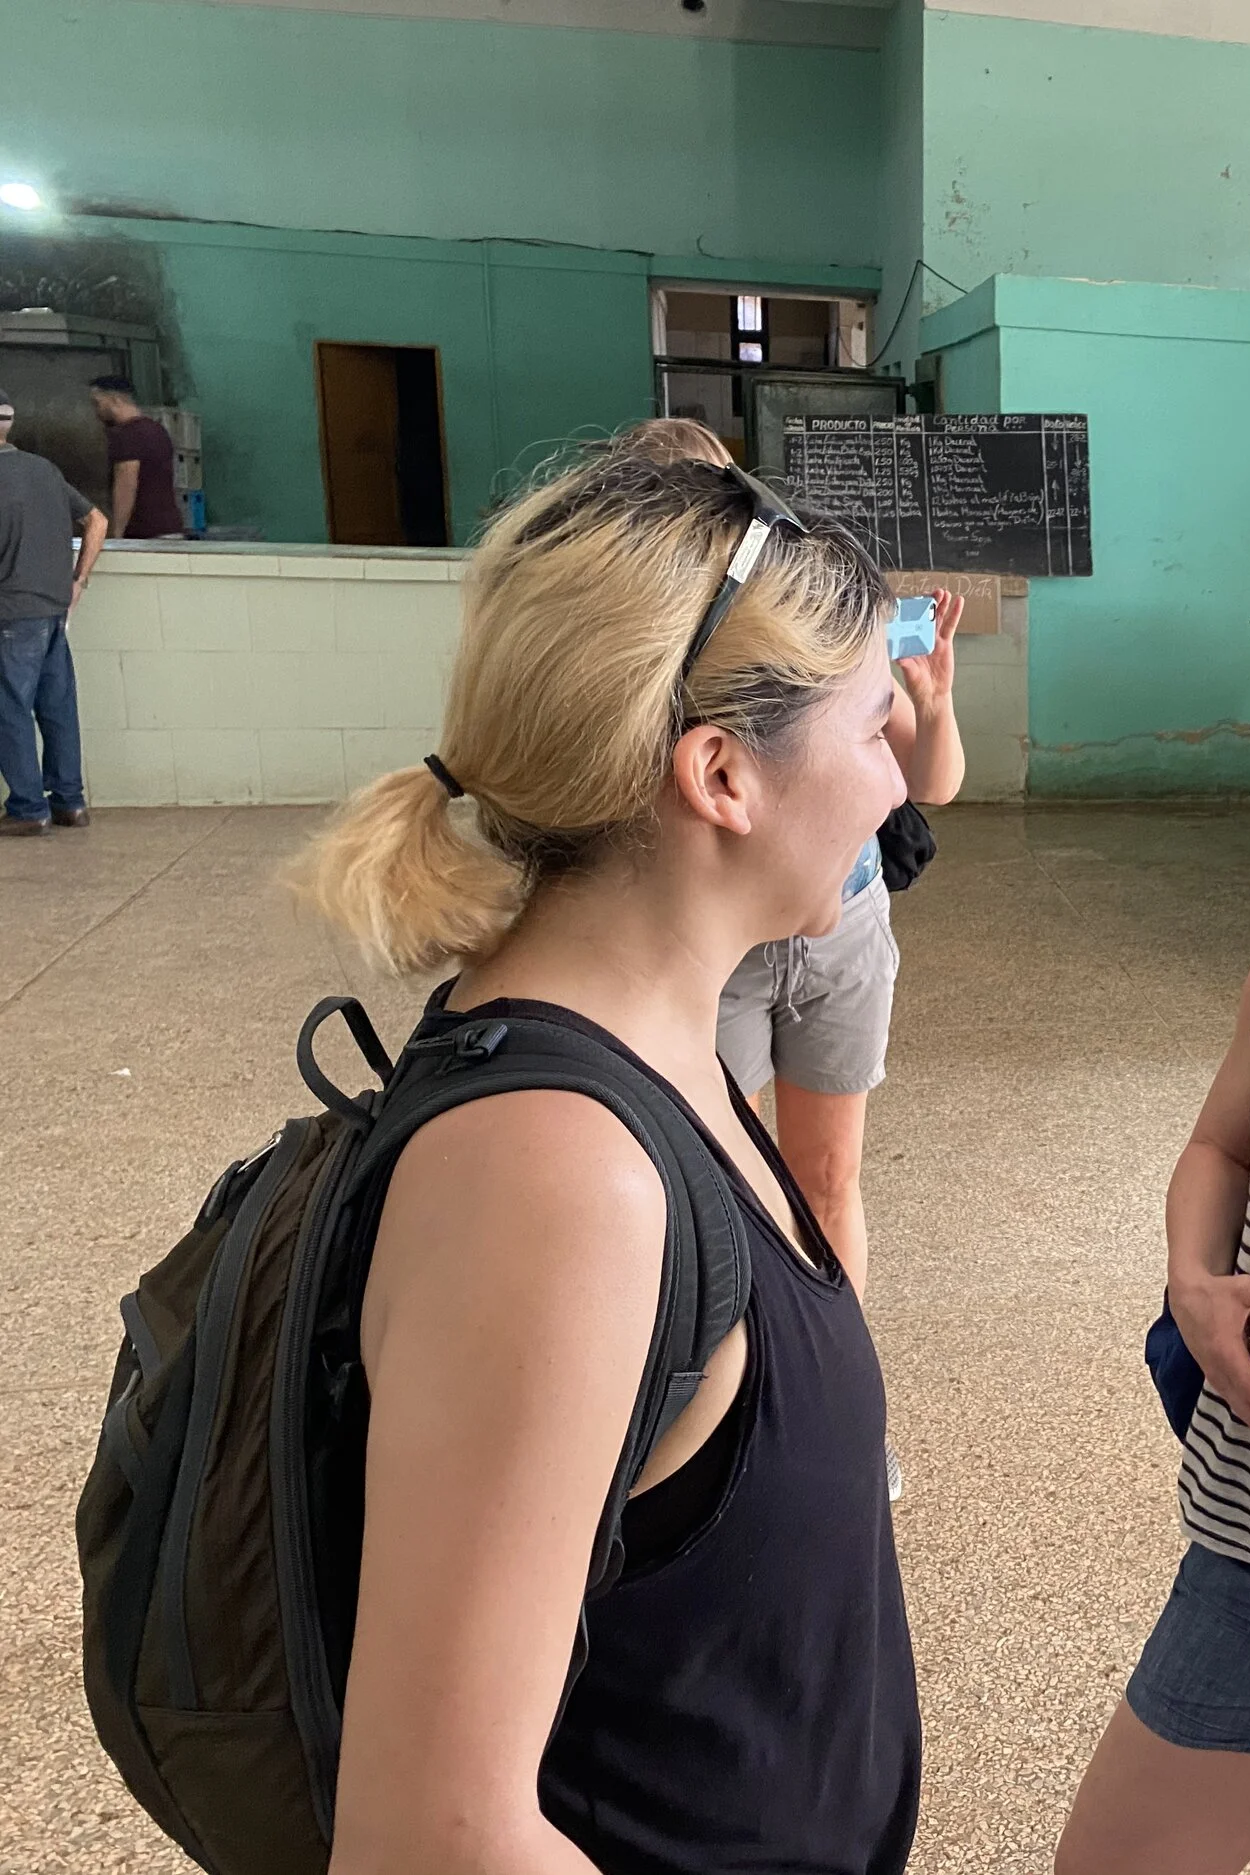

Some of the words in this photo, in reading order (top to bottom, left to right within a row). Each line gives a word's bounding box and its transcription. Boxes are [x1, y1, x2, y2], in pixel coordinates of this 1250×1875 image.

[933, 414, 999, 425] Cantidad
[812, 419, 867, 431] PRODUCTO
[875, 448, 893, 456] 250
[876, 477, 893, 487] 250
[877, 488, 894, 497] 200
